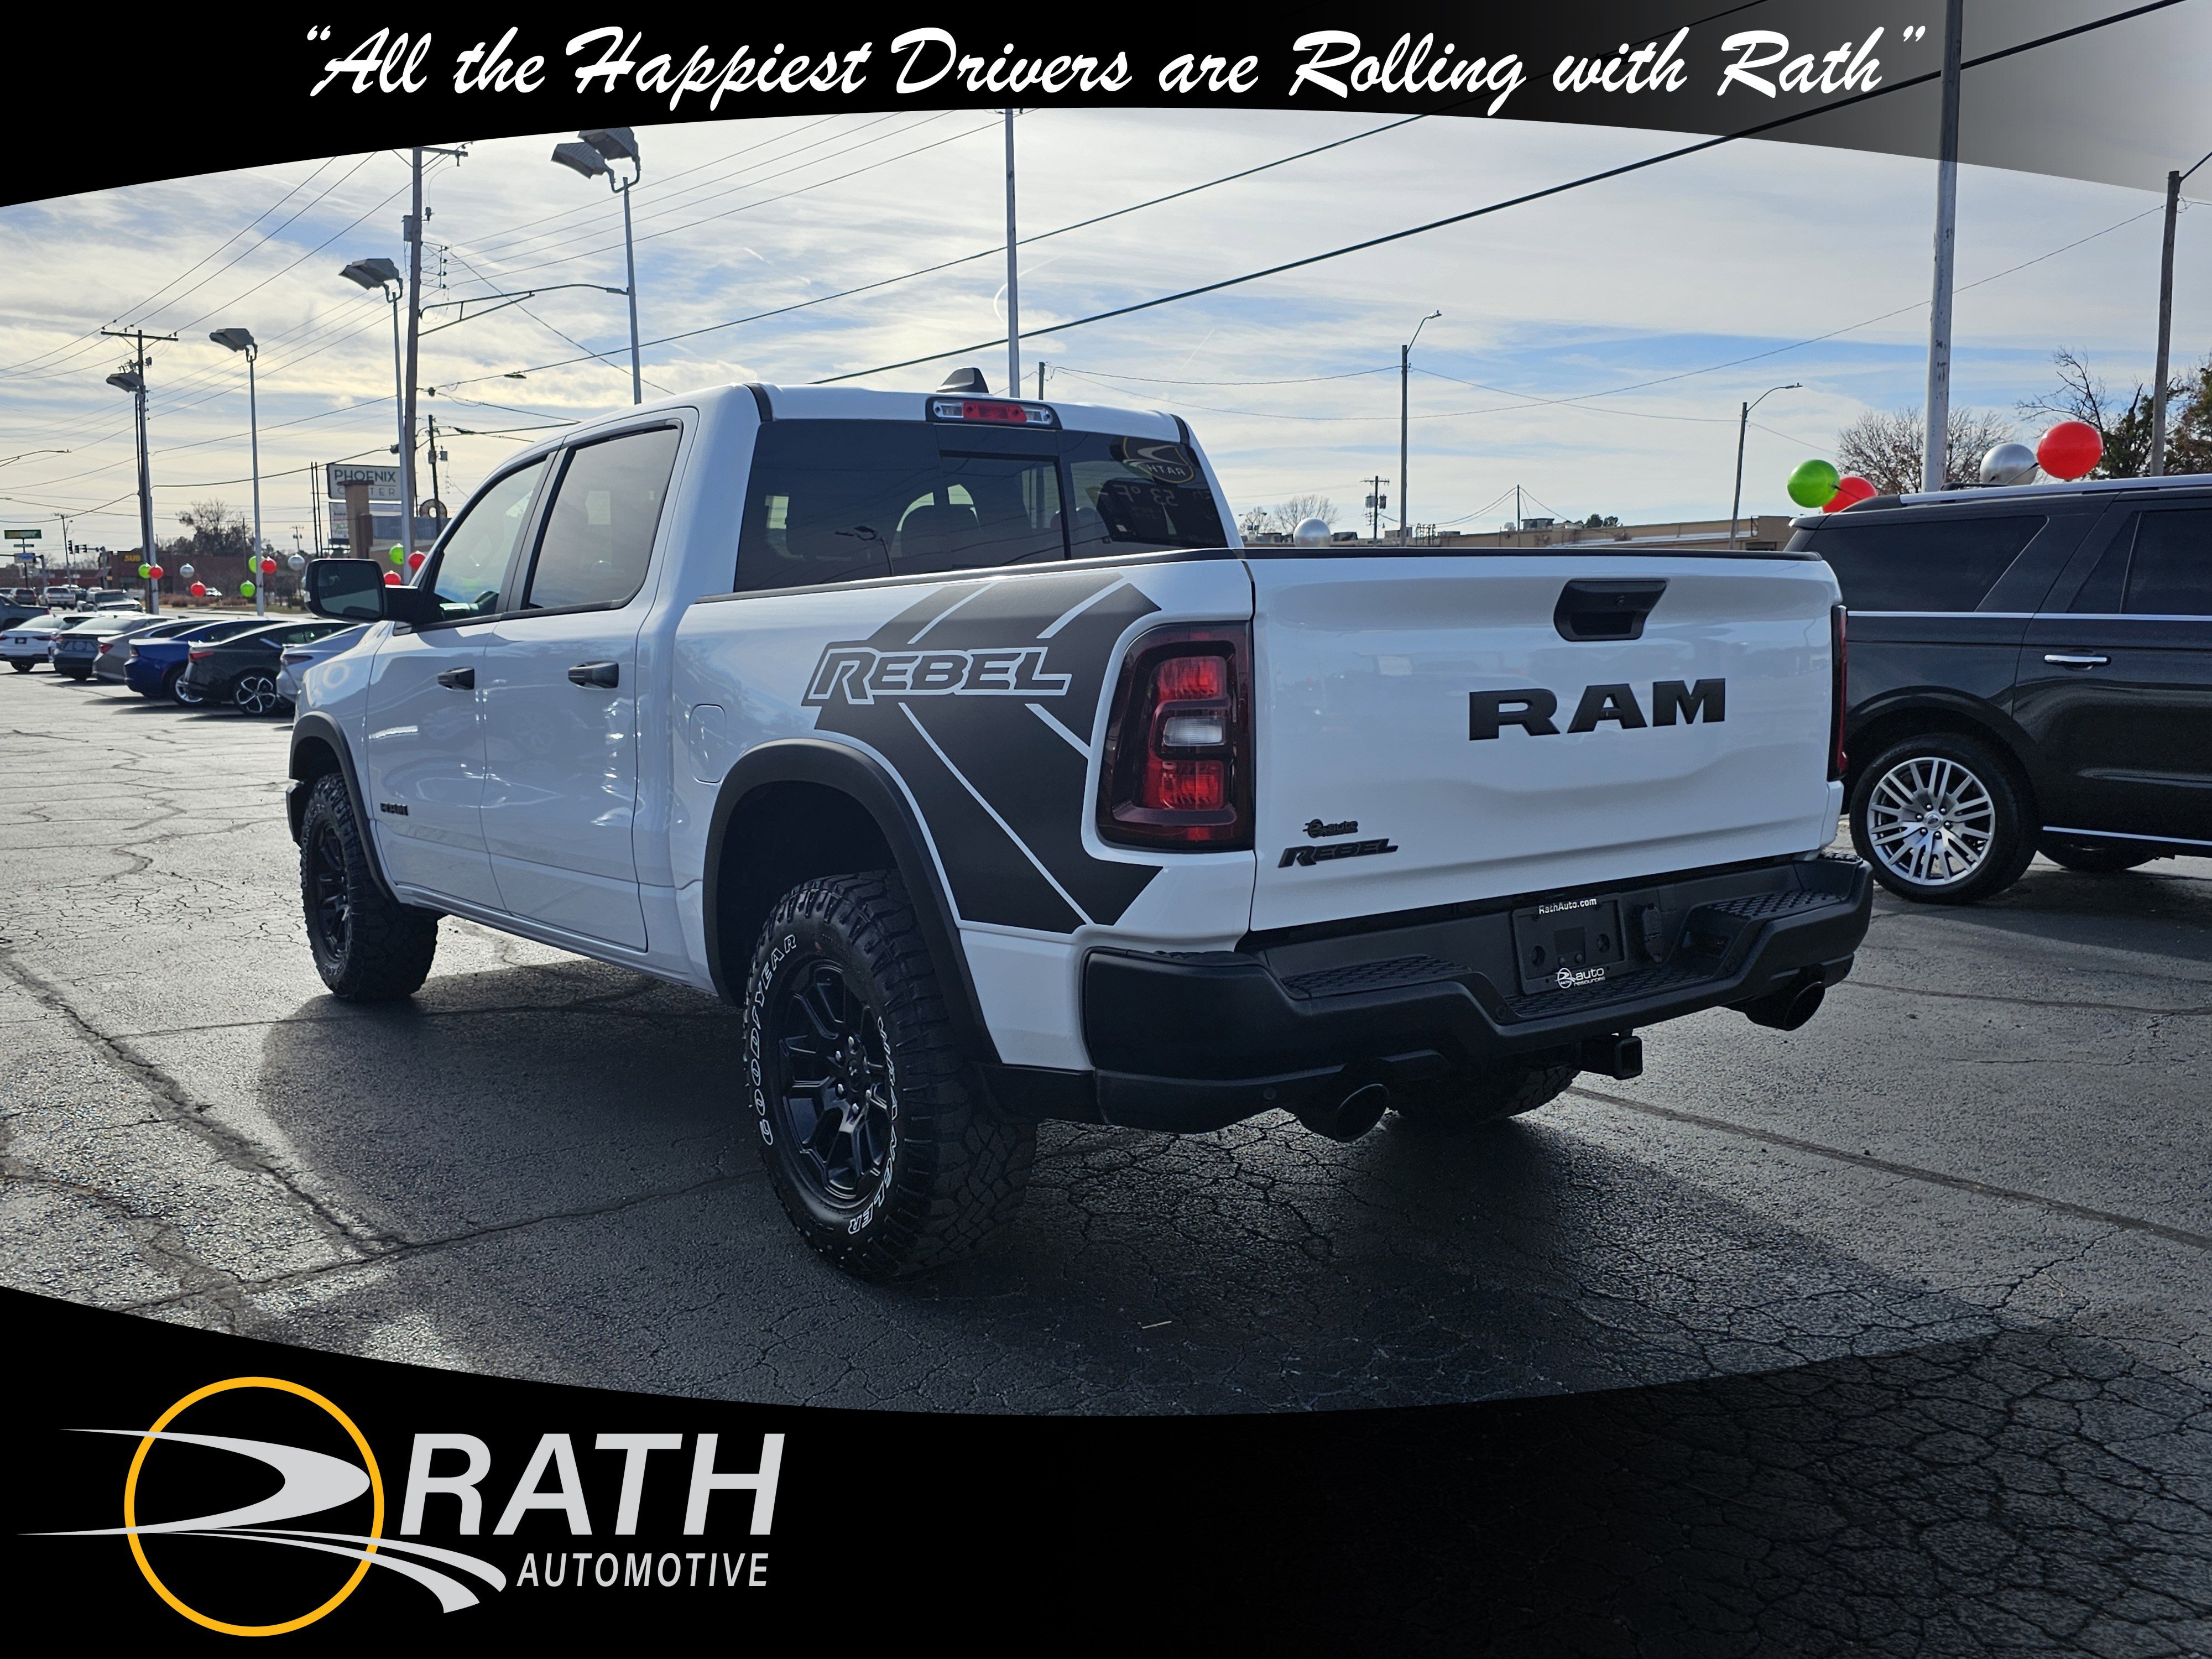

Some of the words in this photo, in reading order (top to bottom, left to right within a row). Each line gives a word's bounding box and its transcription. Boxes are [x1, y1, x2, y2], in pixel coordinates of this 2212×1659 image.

[334, 469, 397, 483] PHOENIX
[337, 487, 395, 496] CTER
[807, 646, 1073, 705] REBEL
[1469, 678, 1726, 741] RAM
[380, 802, 409, 816] RAM
[1277, 838, 1399, 868] REBEL
[1538, 898, 1598, 914] RathAuto.com
[1575, 968, 1605, 981] auto
[750, 934, 797, 1146] GOODYEAR
